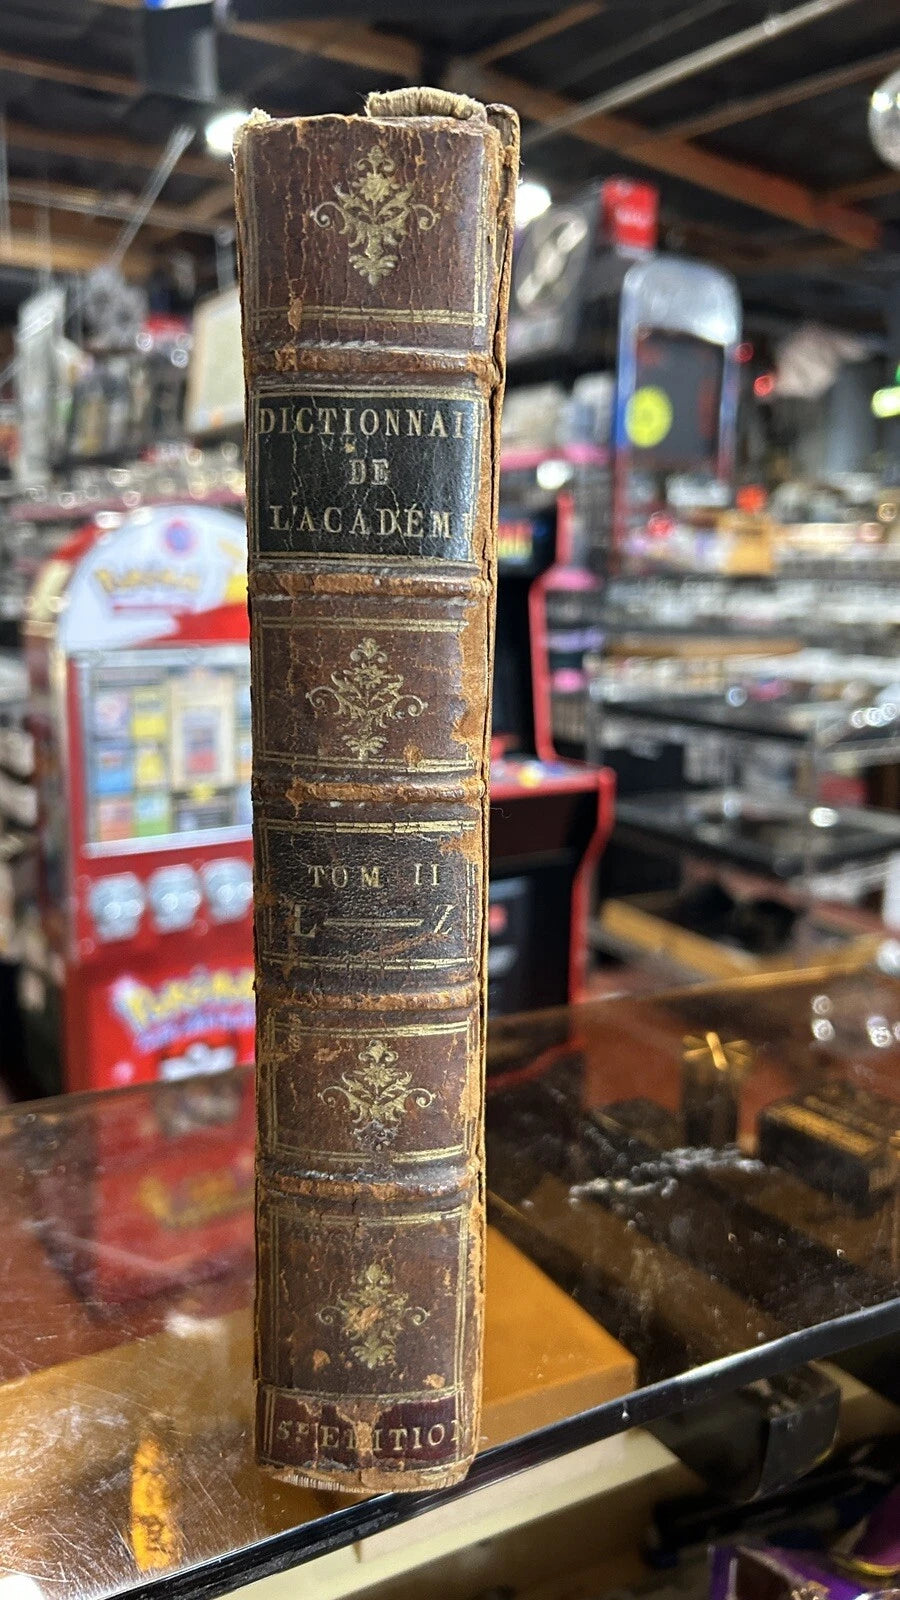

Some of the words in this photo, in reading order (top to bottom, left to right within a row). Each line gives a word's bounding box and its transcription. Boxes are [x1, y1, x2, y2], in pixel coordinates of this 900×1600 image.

[349, 457, 390, 486] DE
[308, 864, 383, 889] TOM
[413, 862, 441, 887] II
